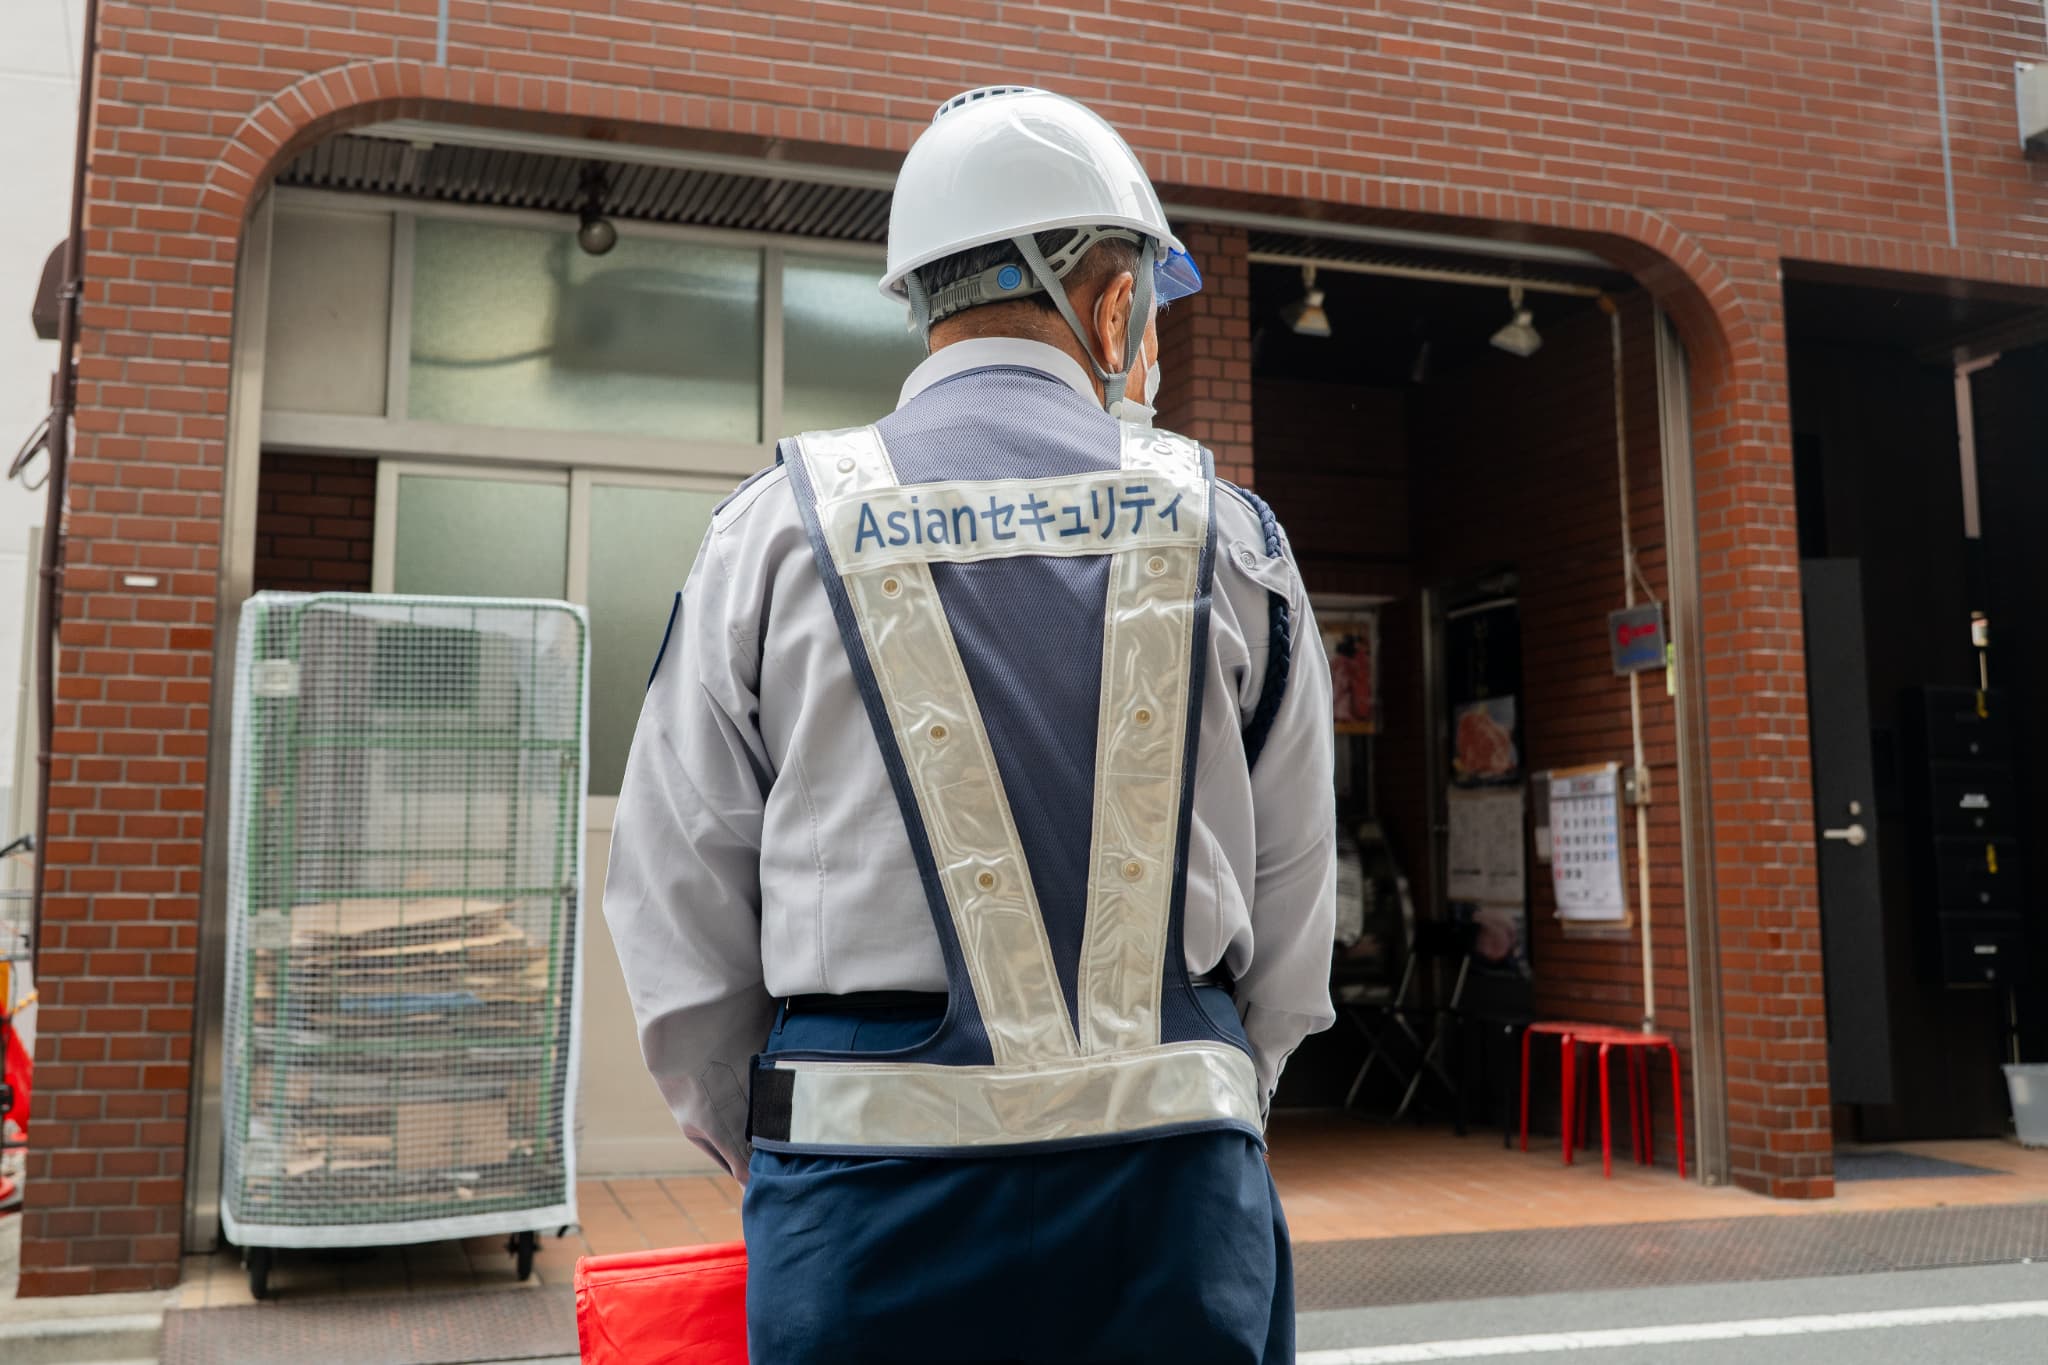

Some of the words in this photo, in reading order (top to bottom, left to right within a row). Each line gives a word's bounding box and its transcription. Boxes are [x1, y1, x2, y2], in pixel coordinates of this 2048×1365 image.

[855, 485, 1183, 553] Asianセキュリティ
